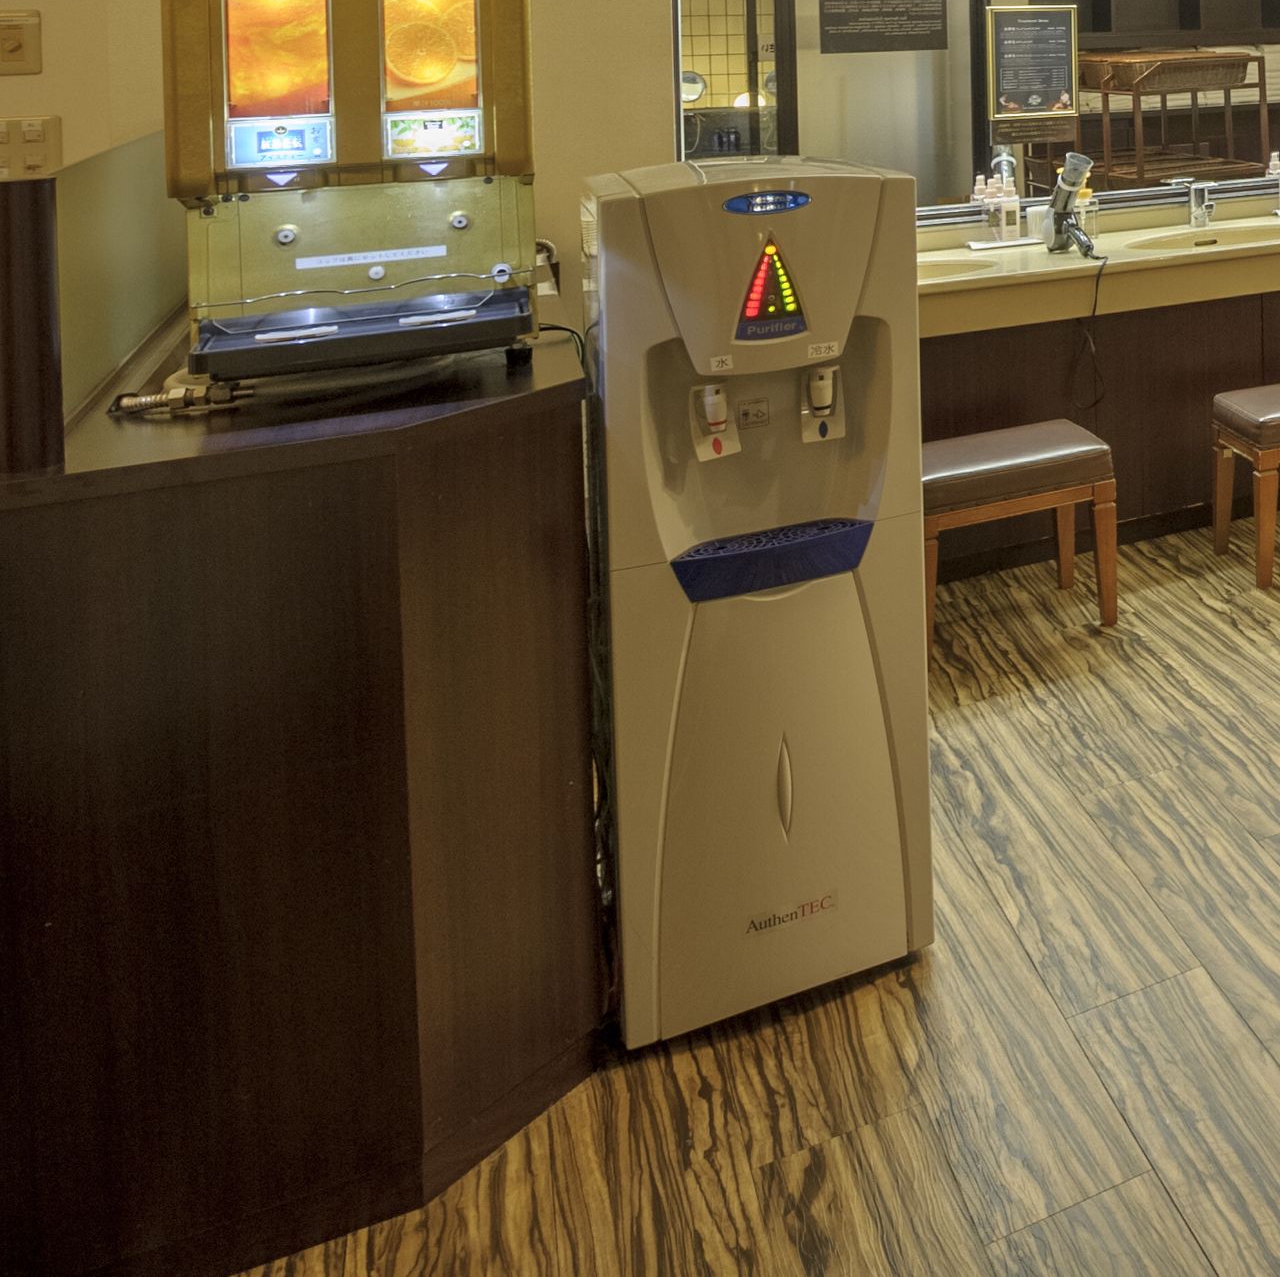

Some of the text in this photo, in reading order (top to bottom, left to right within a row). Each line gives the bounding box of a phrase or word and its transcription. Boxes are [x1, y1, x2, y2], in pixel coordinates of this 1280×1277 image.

[746, 322, 797, 336] Purifier
[810, 343, 836, 356] 冷水
[715, 357, 729, 369] 水
